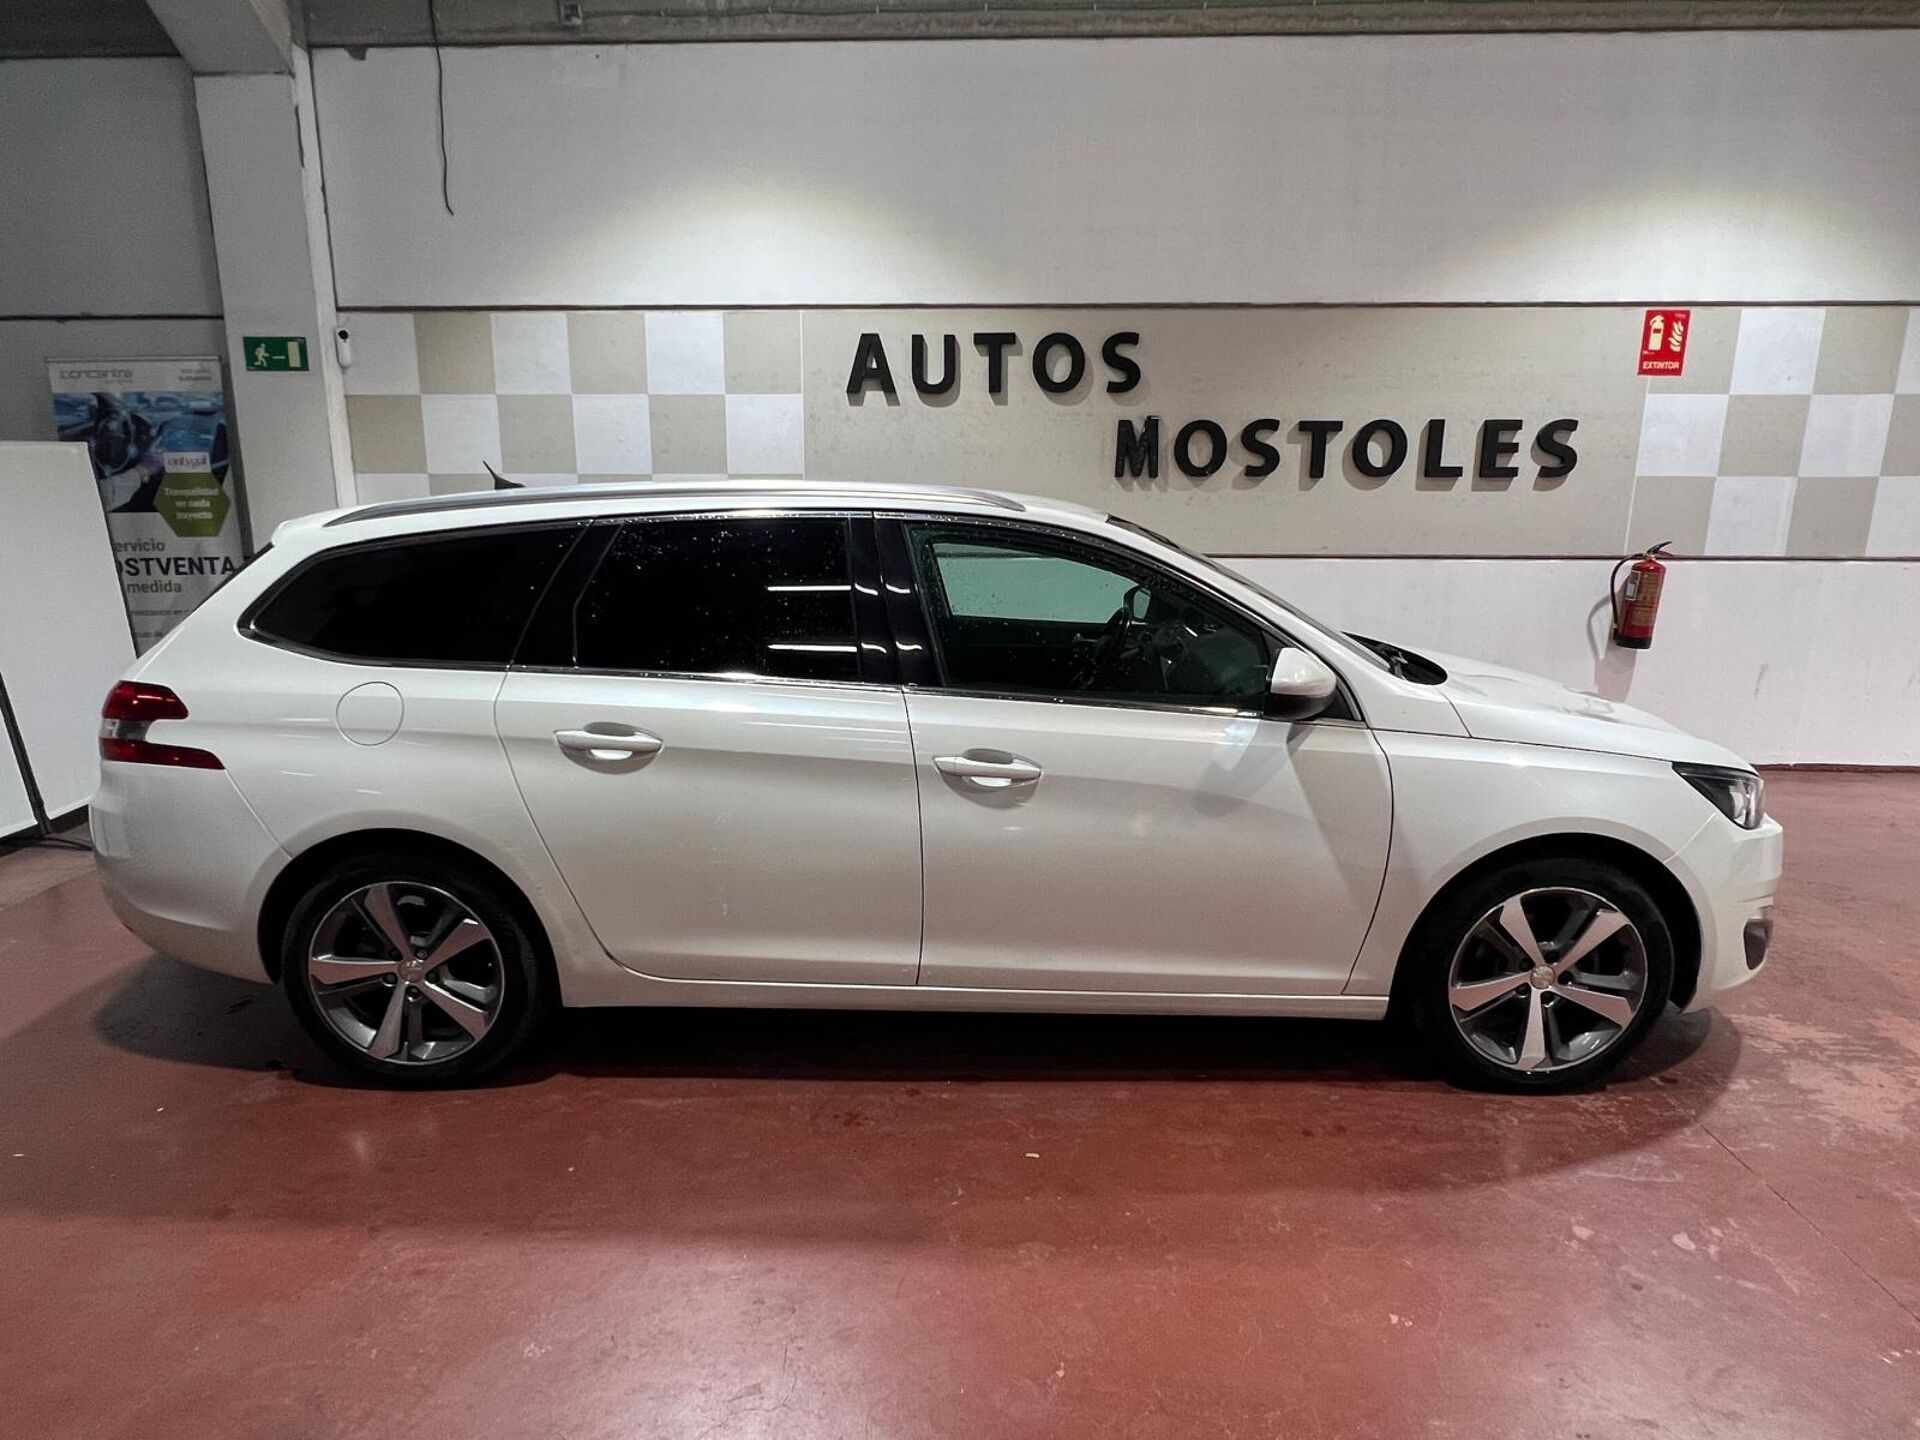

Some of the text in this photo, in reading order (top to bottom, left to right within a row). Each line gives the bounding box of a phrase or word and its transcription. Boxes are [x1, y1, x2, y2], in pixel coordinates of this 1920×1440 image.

[846, 332, 1141, 395] AUTOS
[1642, 361, 1680, 370] EXTINTOR
[1114, 416, 1579, 479] MOSTOLES
[113, 538, 165, 552] ervicio
[117, 556, 236, 576] STVENTA
[126, 580, 182, 593] medida
